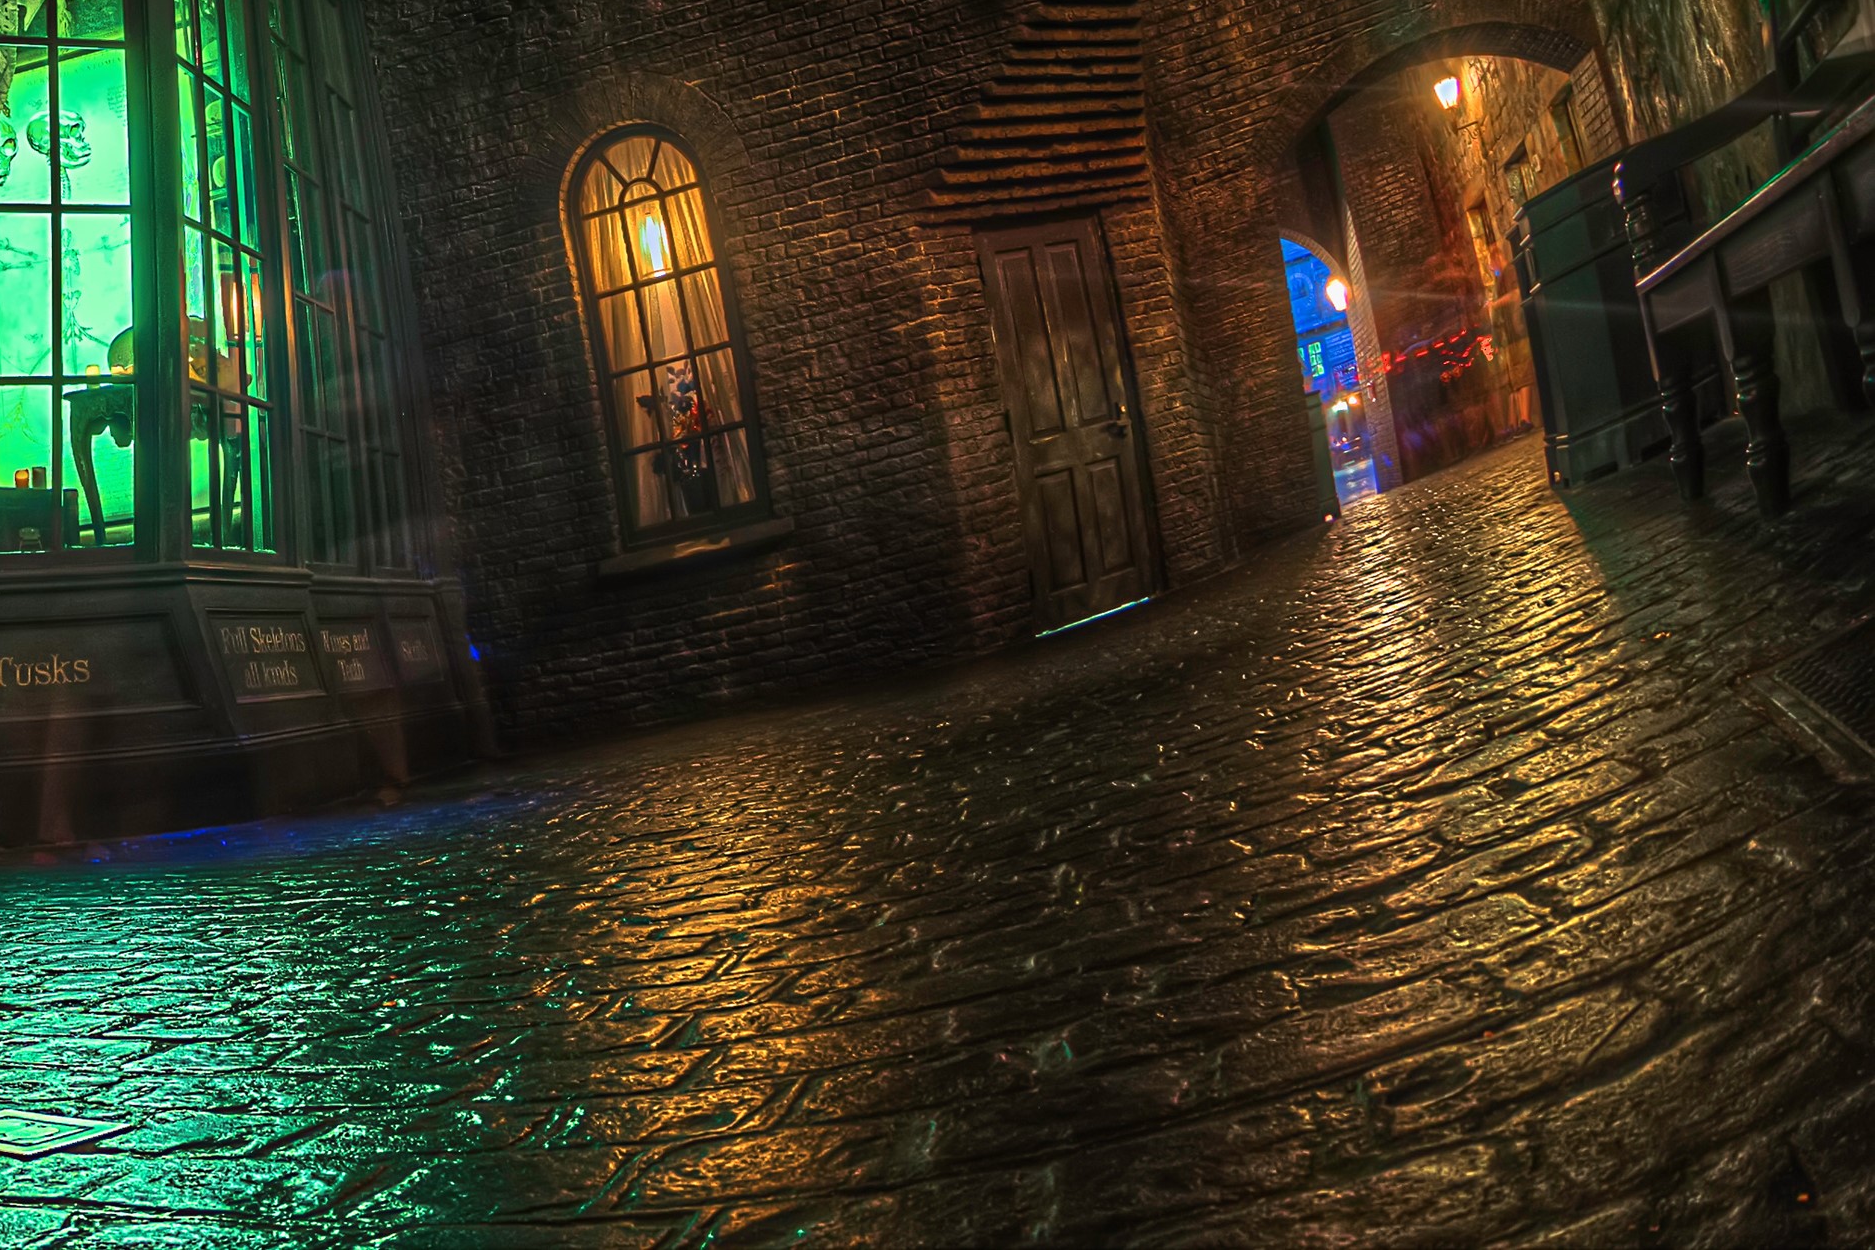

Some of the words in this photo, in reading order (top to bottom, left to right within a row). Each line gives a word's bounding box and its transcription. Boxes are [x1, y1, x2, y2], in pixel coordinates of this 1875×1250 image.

[220, 627, 249, 655] Full
[249, 627, 306, 654] Skeletons
[353, 628, 370, 651] and
[245, 661, 263, 689] all
[262, 659, 299, 687] kinds
